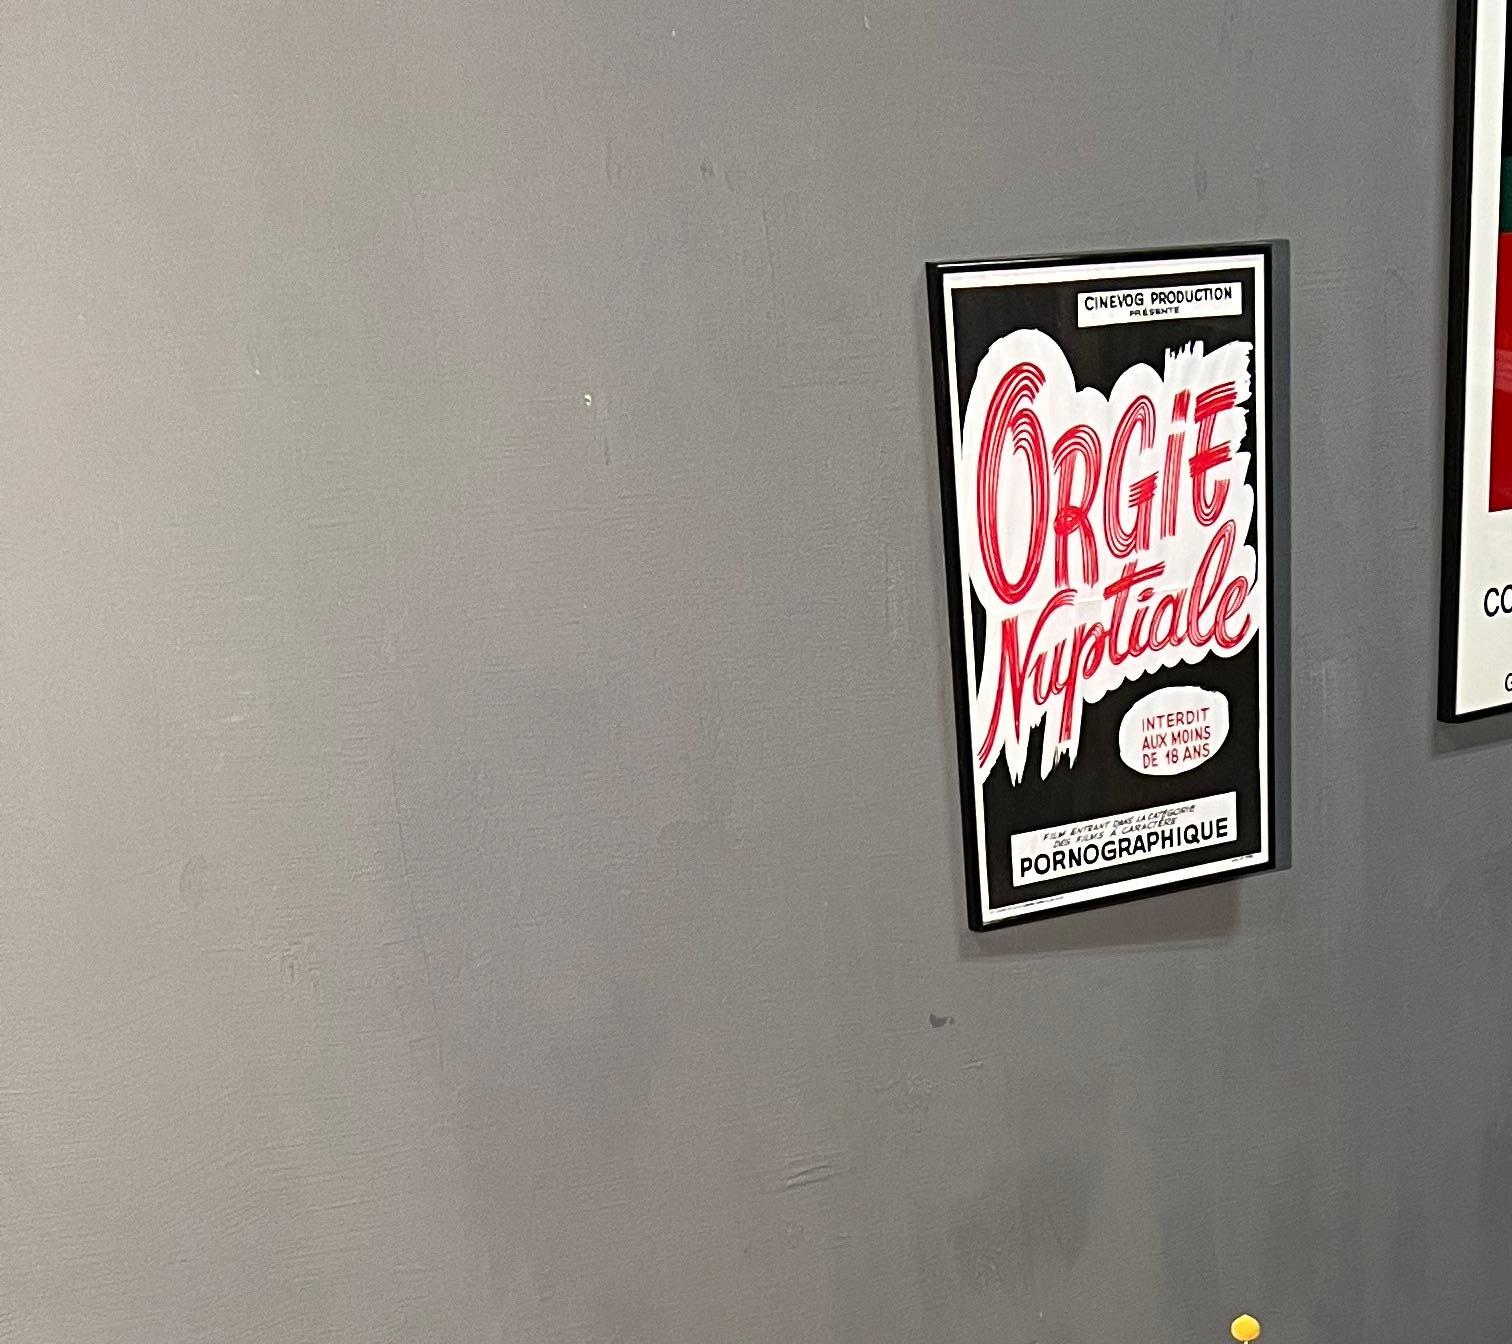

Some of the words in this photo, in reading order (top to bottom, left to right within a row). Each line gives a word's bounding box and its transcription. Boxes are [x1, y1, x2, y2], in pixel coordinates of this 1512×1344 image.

[1084, 292, 1144, 311] CINEVOG
[1150, 286, 1233, 305] PRODUCTION
[977, 519, 1251, 768] Nuptiale
[1142, 707, 1210, 733] INTERDIT
[1142, 732, 1167, 751] AUX
[1171, 725, 1211, 746] MOINS
[1142, 752, 1158, 769] DE
[1165, 747, 1179, 766] 18
[1182, 743, 1210, 763] ANS
[1020, 817, 1228, 878] PORNOGRAPHIQUE
